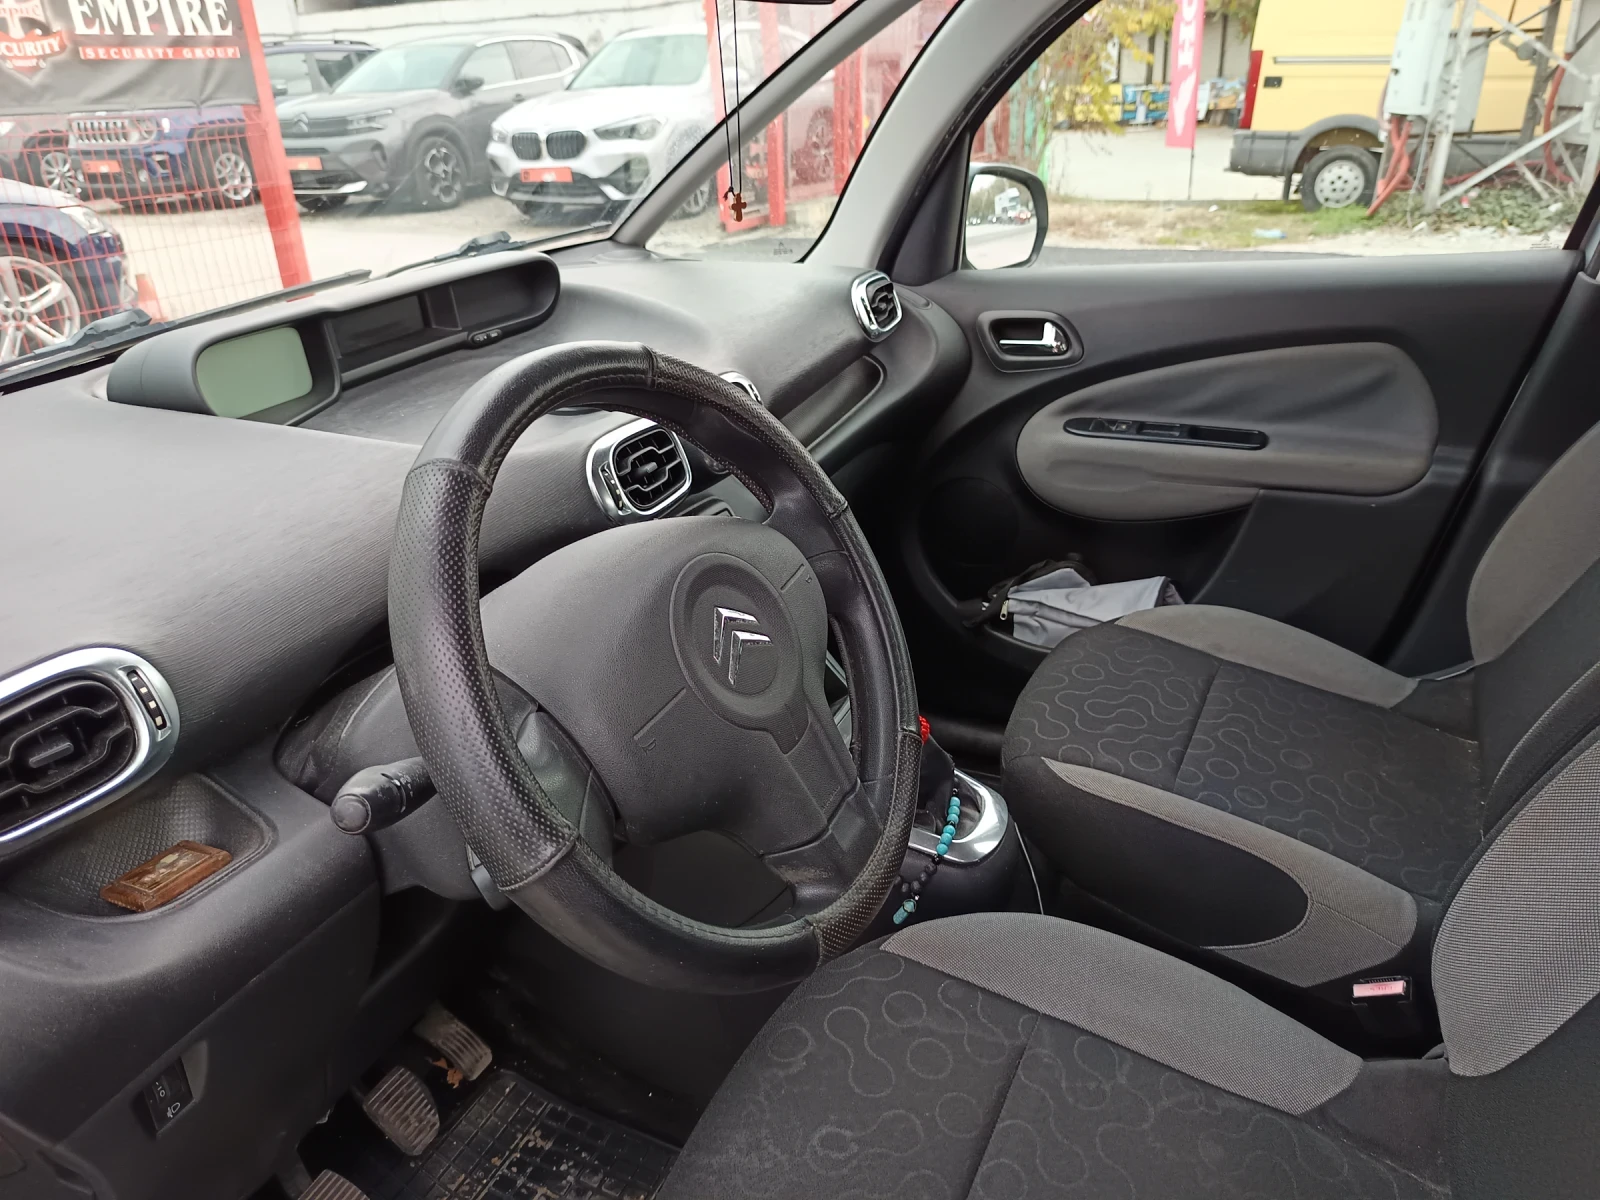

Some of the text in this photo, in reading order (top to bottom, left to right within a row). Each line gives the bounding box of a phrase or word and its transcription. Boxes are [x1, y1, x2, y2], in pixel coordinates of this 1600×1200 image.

[67, 0, 233, 36] EMPIRE
[0, 35, 61, 57] CURITY
[85, 47, 235, 59] SECURITY GROUP
